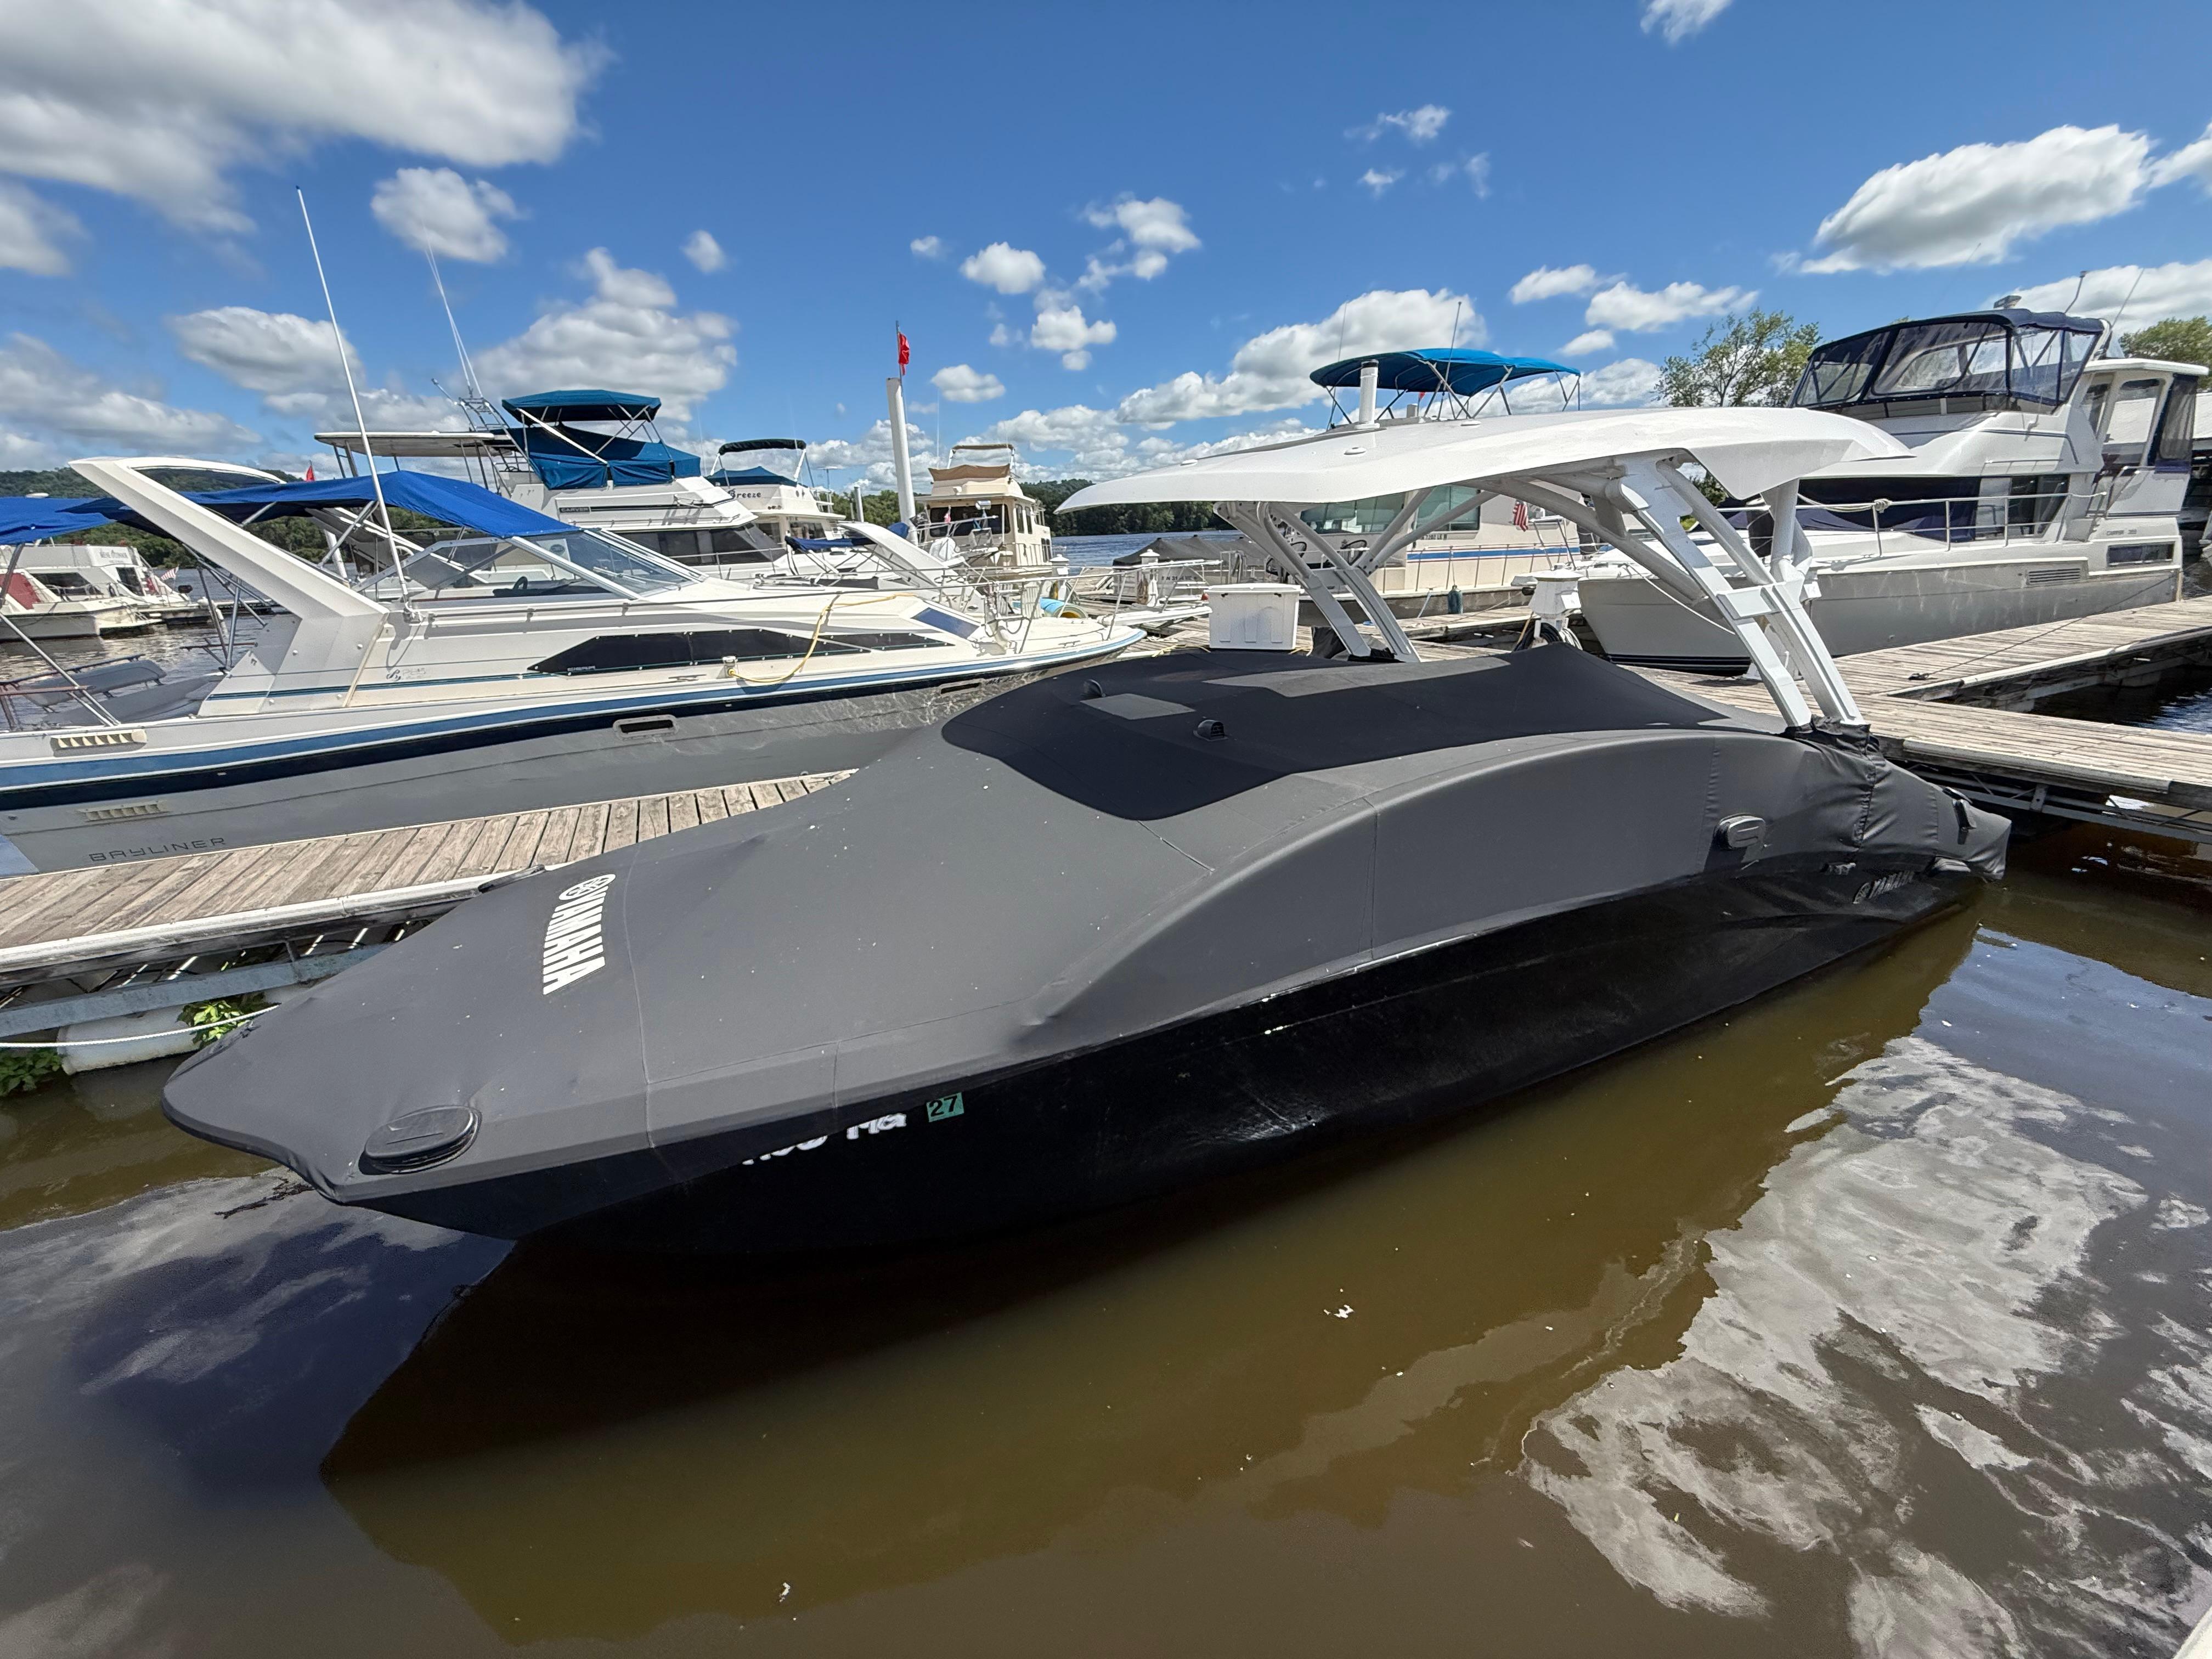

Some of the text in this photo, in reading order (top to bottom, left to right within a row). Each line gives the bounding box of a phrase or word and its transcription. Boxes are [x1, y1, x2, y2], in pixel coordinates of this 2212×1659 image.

[88, 838, 226, 862] BAYLINER
[543, 885, 609, 995] YAMAHA
[929, 1095, 958, 1117] 27
